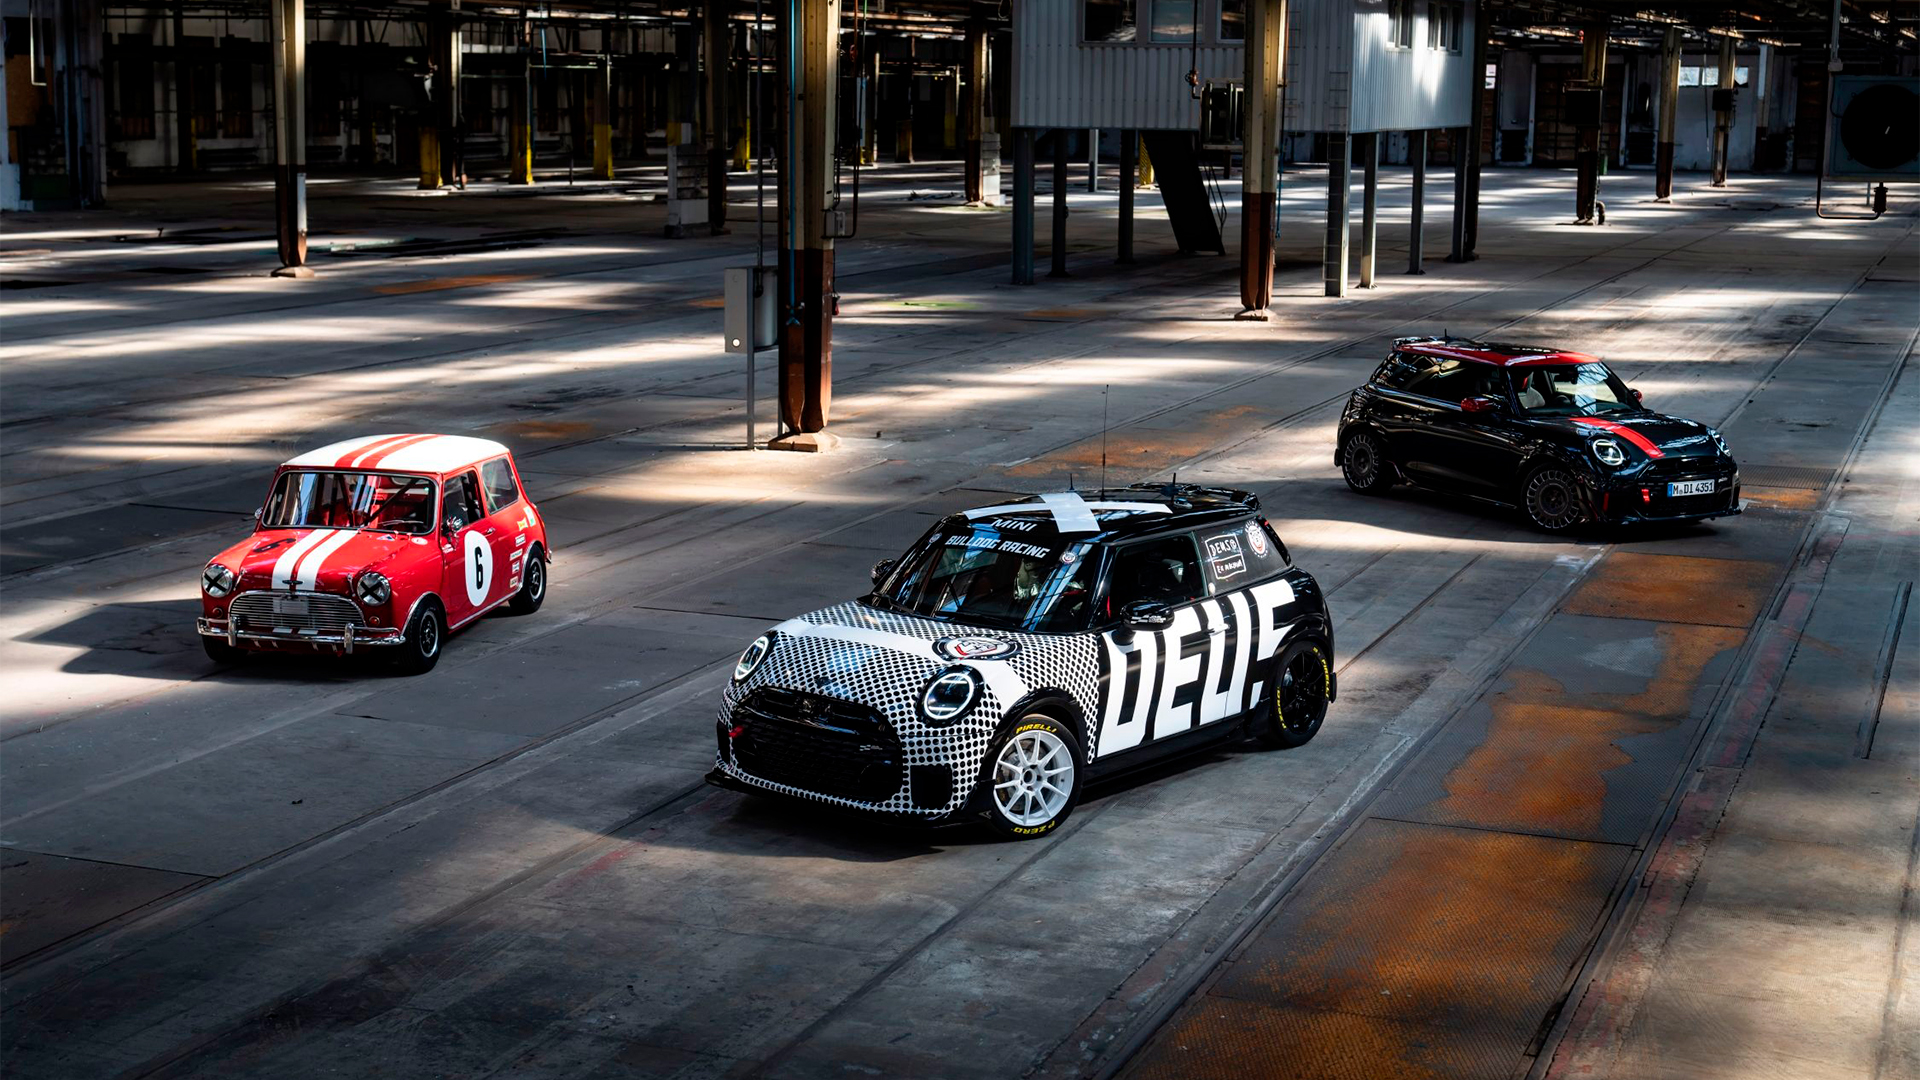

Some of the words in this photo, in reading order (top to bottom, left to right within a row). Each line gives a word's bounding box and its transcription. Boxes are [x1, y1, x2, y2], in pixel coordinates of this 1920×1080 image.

[1695, 482, 1713, 492] 4351
[991, 518, 1038, 532] MINI
[945, 535, 1001, 549] BULLDOG
[1000, 540, 1050, 559] RACING
[475, 546, 484, 590] 6
[1016, 723, 1057, 735] PIRELLI
[1013, 826, 1047, 835] ZERO
